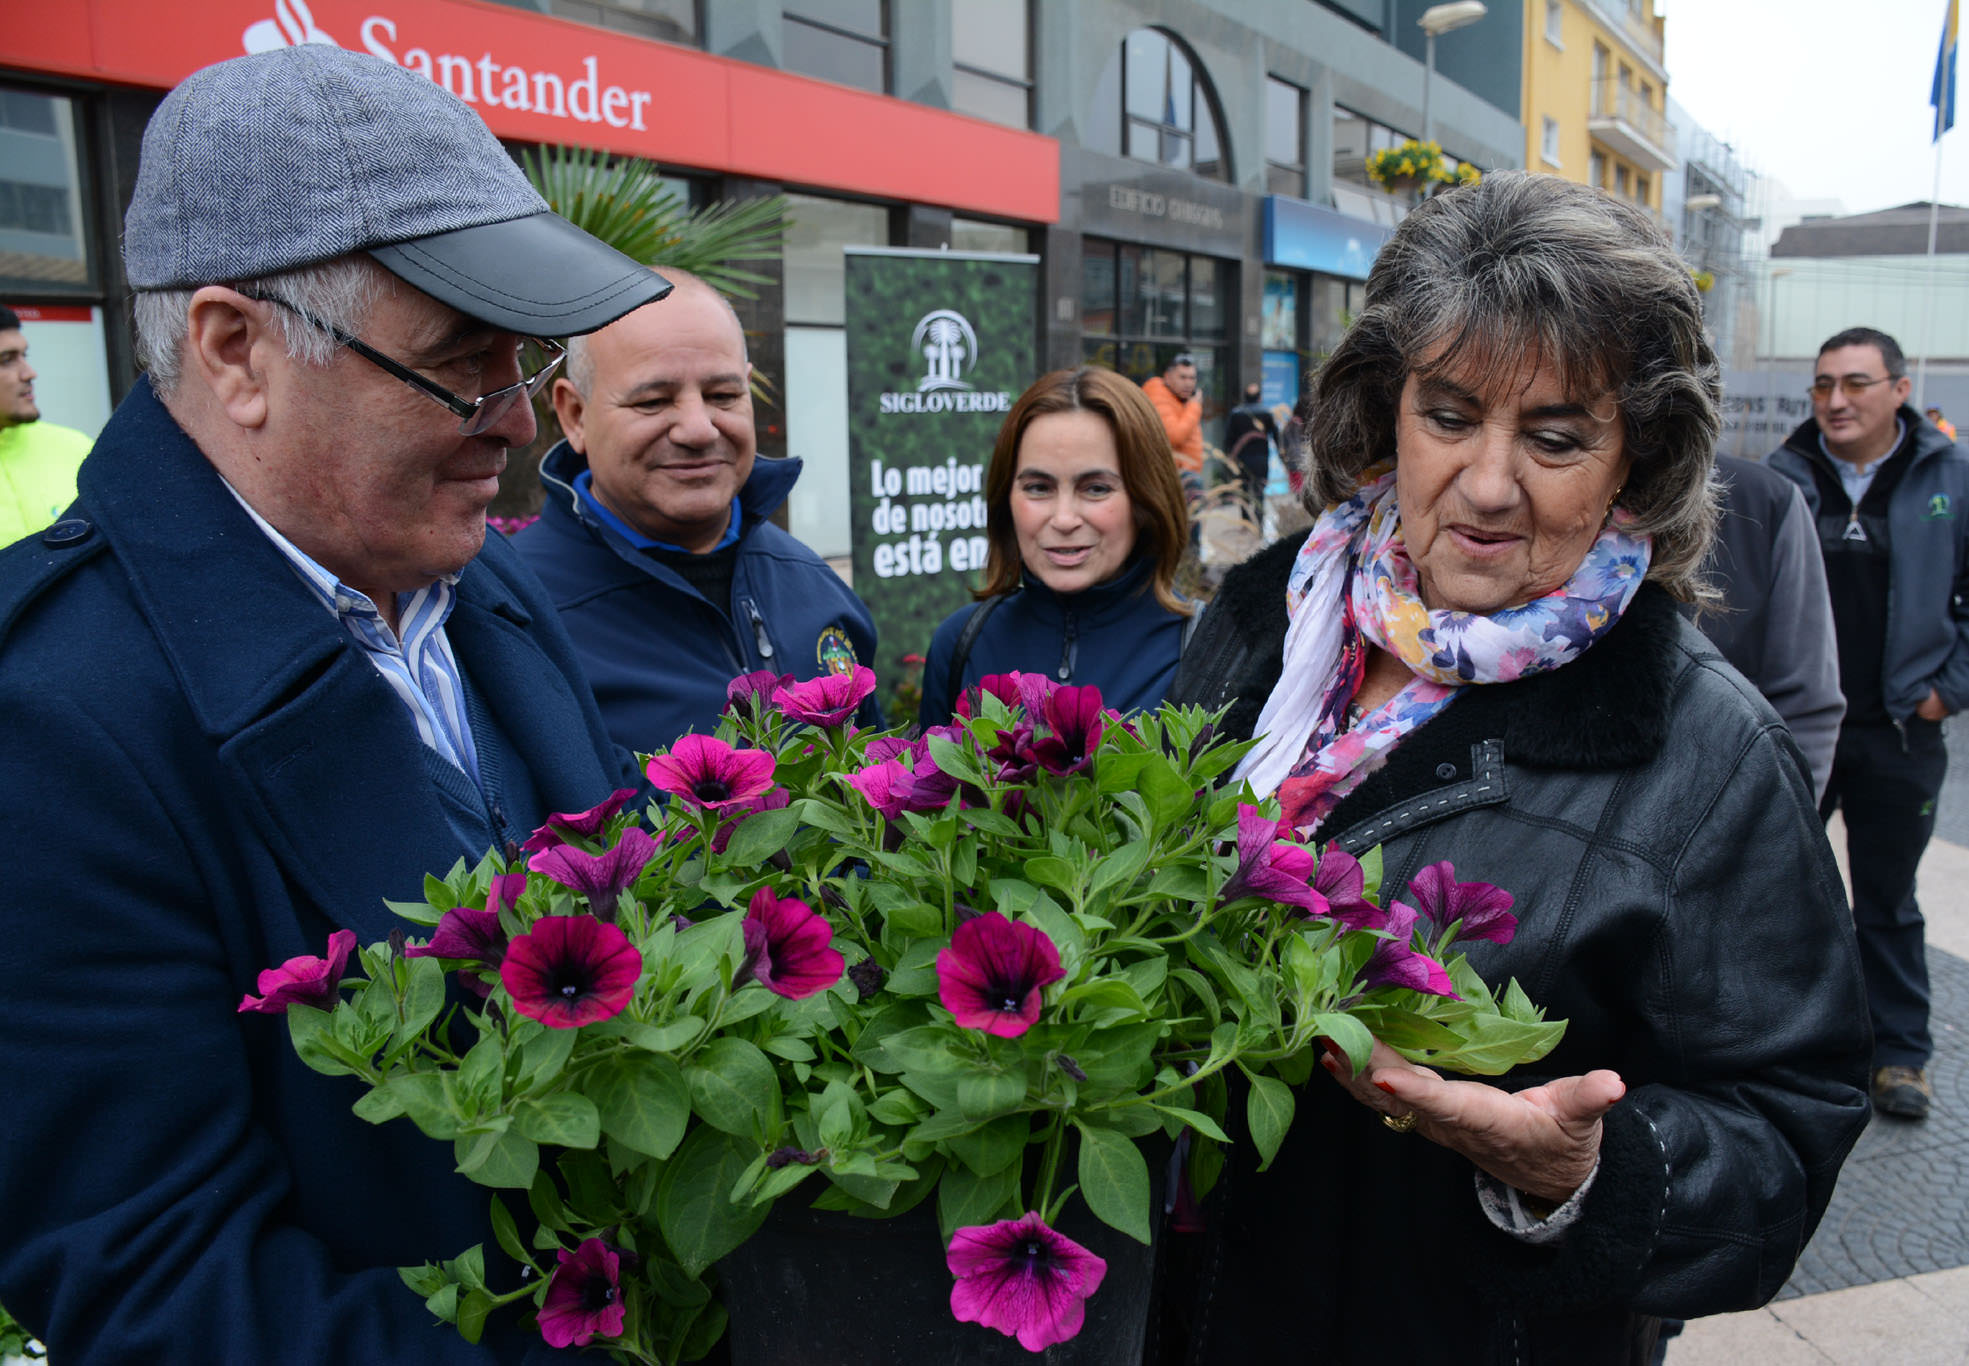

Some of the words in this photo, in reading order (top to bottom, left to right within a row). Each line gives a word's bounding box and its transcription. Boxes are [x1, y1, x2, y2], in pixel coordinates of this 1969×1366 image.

[360, 15, 652, 132] Santander
[880, 391, 1011, 414] SIGLOVERDE
[871, 459, 902, 497] Lo
[906, 456, 983, 499] mejor
[872, 497, 906, 535] de
[873, 530, 943, 578] está
[948, 535, 990, 572] en
